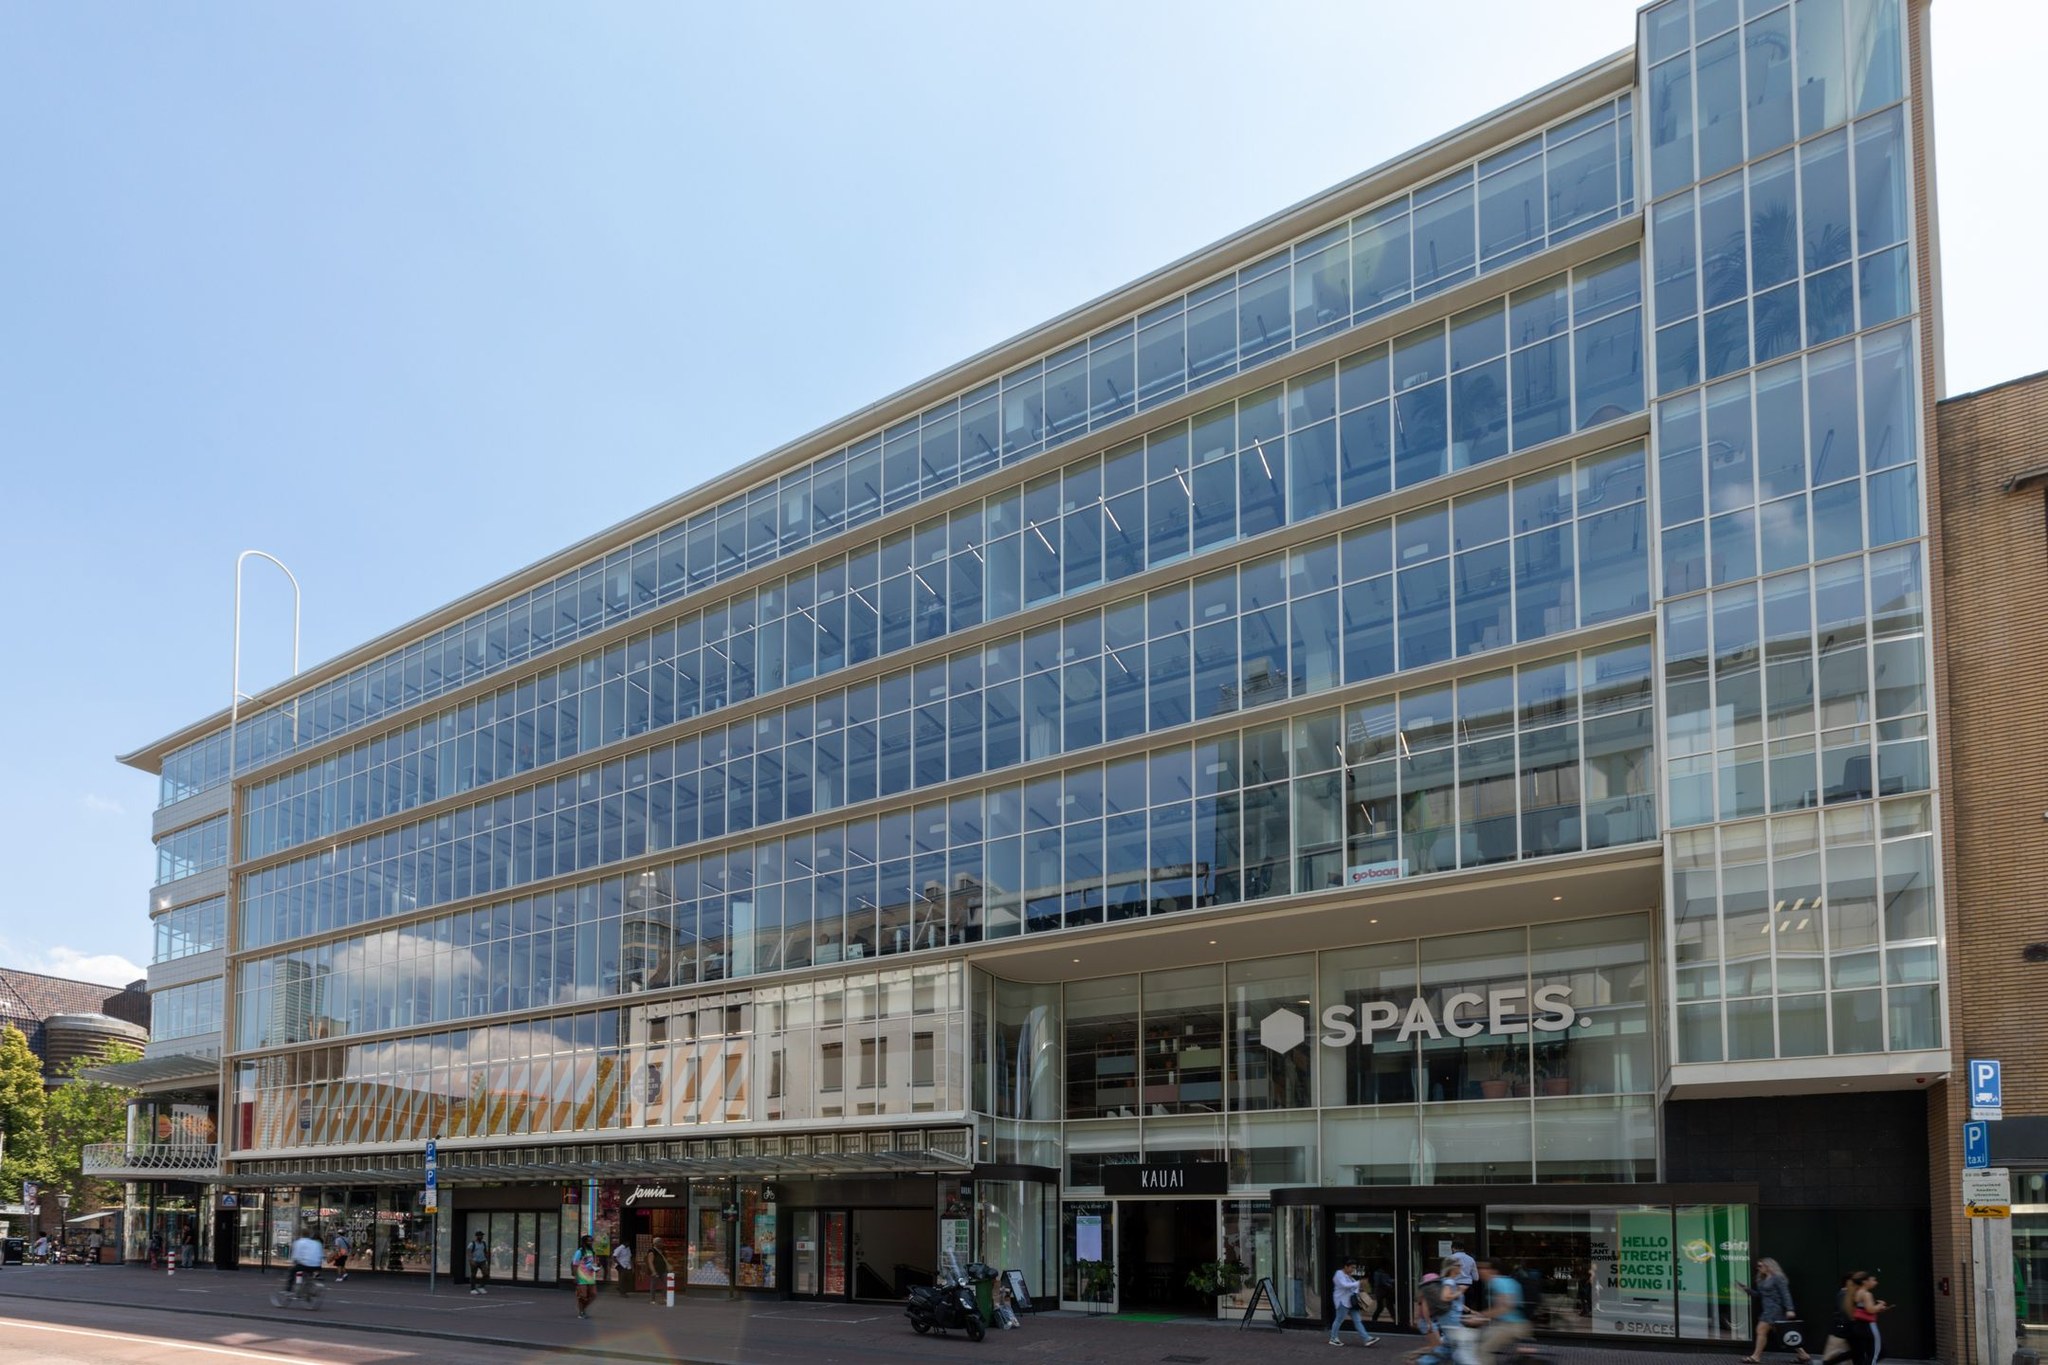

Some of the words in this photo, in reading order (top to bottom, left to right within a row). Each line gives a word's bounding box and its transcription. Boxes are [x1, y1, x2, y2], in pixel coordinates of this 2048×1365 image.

[1320, 984, 1593, 1048] SPACES.
[1978, 1064, 1994, 1088] P
[1968, 1126, 1981, 1150] P
[427, 1143, 434, 1154] P
[1967, 1153, 1985, 1165] taxi
[427, 1170, 434, 1182] P
[1141, 1169, 1184, 1188] KAUAI
[1622, 1236, 1668, 1248] HELLO
[1612, 1250, 1681, 1263] UTRECH,
[1609, 1264, 1664, 1276] SPACES
[1607, 1277, 1662, 1290] MOVING
